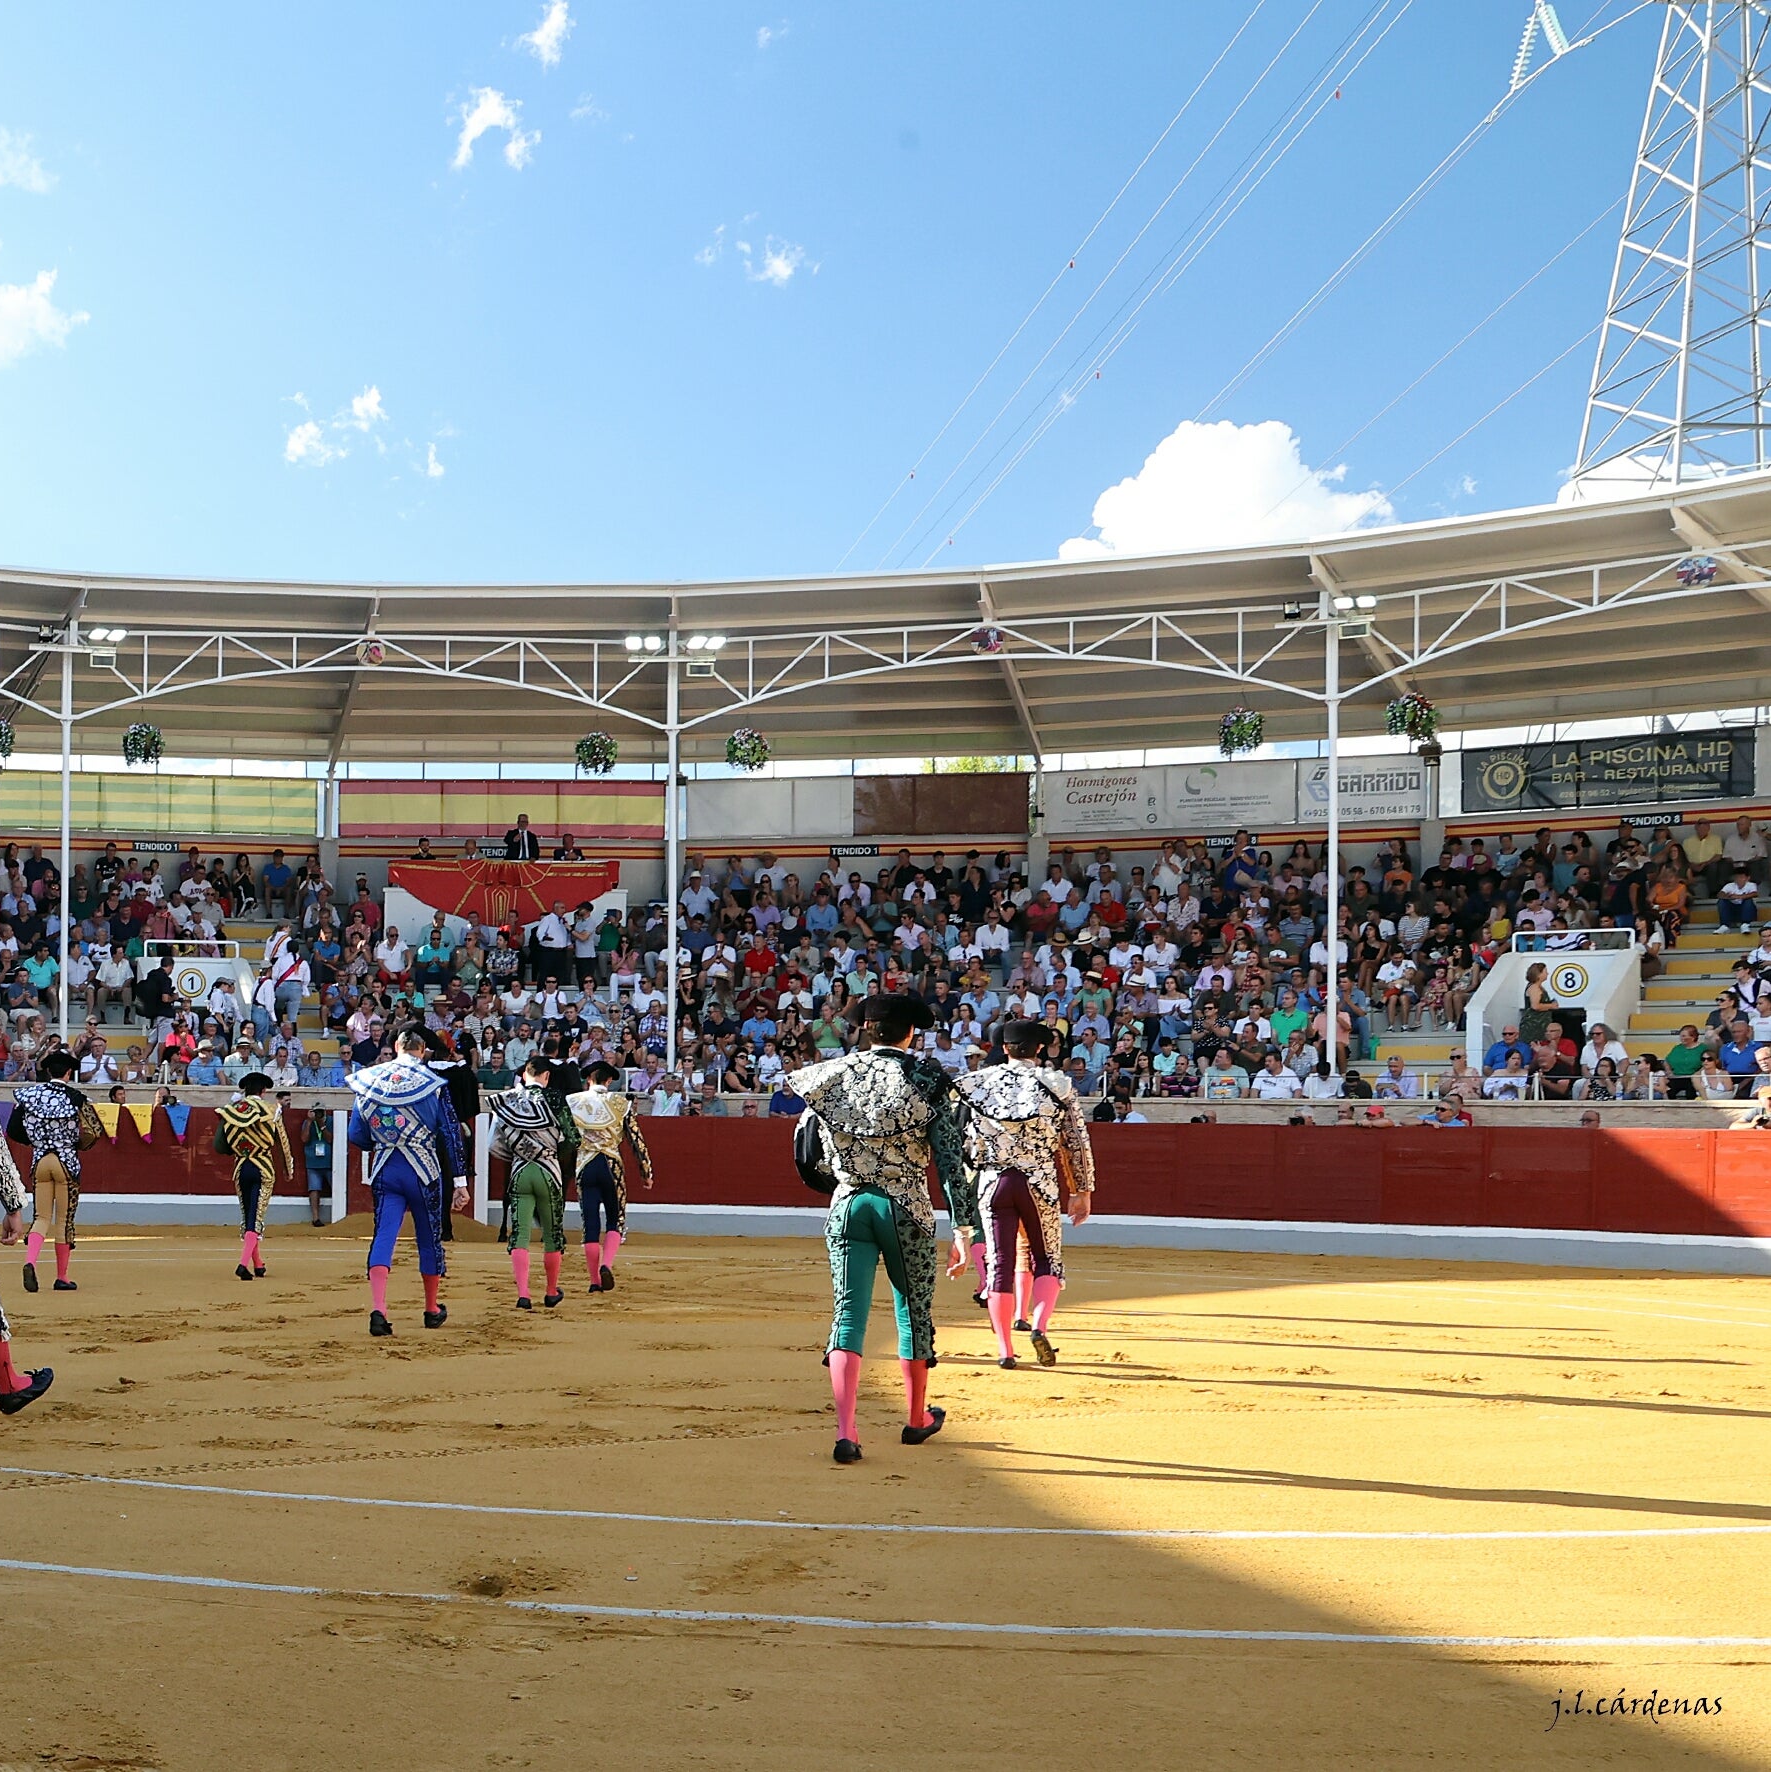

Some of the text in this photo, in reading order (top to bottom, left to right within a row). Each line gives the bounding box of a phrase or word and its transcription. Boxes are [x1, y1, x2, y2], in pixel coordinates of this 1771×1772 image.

[1551, 740, 1734, 768] LA PISCINA HD
[1551, 771, 1586, 784] BAR
[1604, 760, 1731, 781] RESTAURANTE
[1066, 775, 1138, 789] Hormigones
[1337, 771, 1421, 793] GARRIDO
[1066, 788, 1137, 807] Castrejón
[1313, 808, 1328, 817] 925
[1353, 807, 1364, 815] 58
[1369, 806, 1385, 815] 670
[1387, 806, 1397, 814] 64
[1398, 805, 1409, 814] 81
[1410, 804, 1421, 813] 79
[1621, 815, 1680, 826] TENDIDO 8
[135, 842, 178, 851] TENDIDO 1
[1251, 837, 1257, 845] 8
[481, 848, 508, 857] TENDI
[831, 847, 878, 855] TENDIDO 1
[188, 975, 195, 990] 1
[1564, 971, 1576, 989] 8
